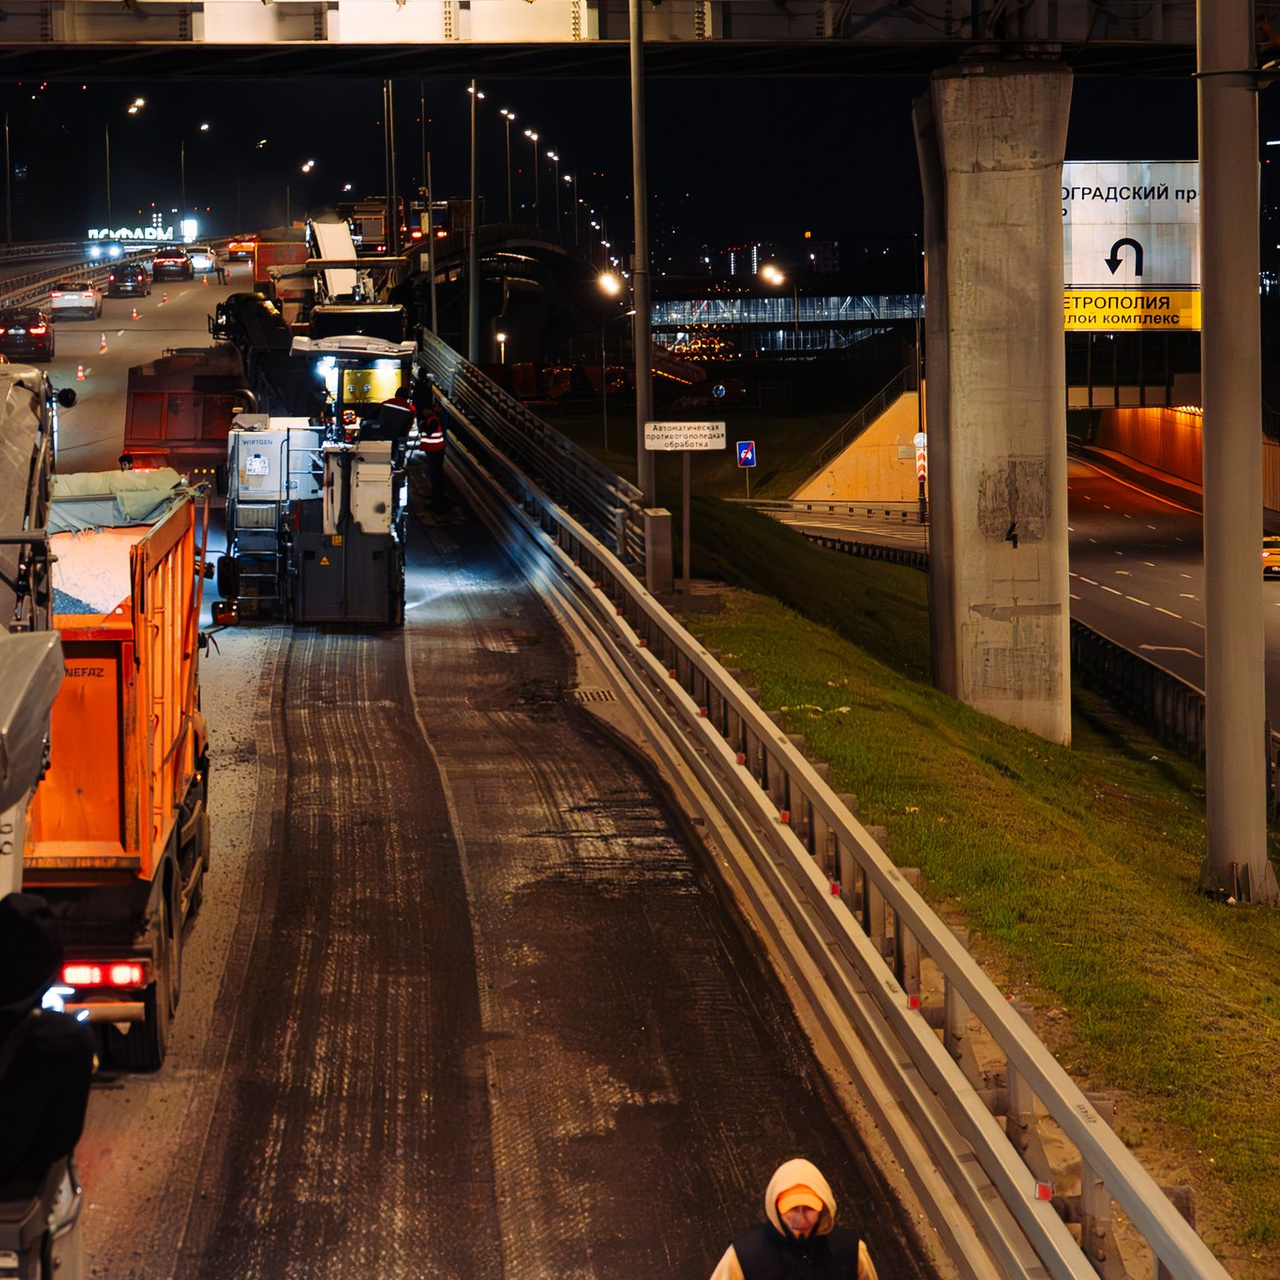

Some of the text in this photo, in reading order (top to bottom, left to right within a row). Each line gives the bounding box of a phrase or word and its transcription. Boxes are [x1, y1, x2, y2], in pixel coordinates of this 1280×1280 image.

[1062, 183, 1169, 202] ОГРАДСКИЙ
[1063, 296, 1170, 310] ЕТРОПОЛИЯ
[1103, 314, 1180, 324] комплекс
[664, 440, 709, 448] обработка
[64, 667, 104, 677] NEFAZ
